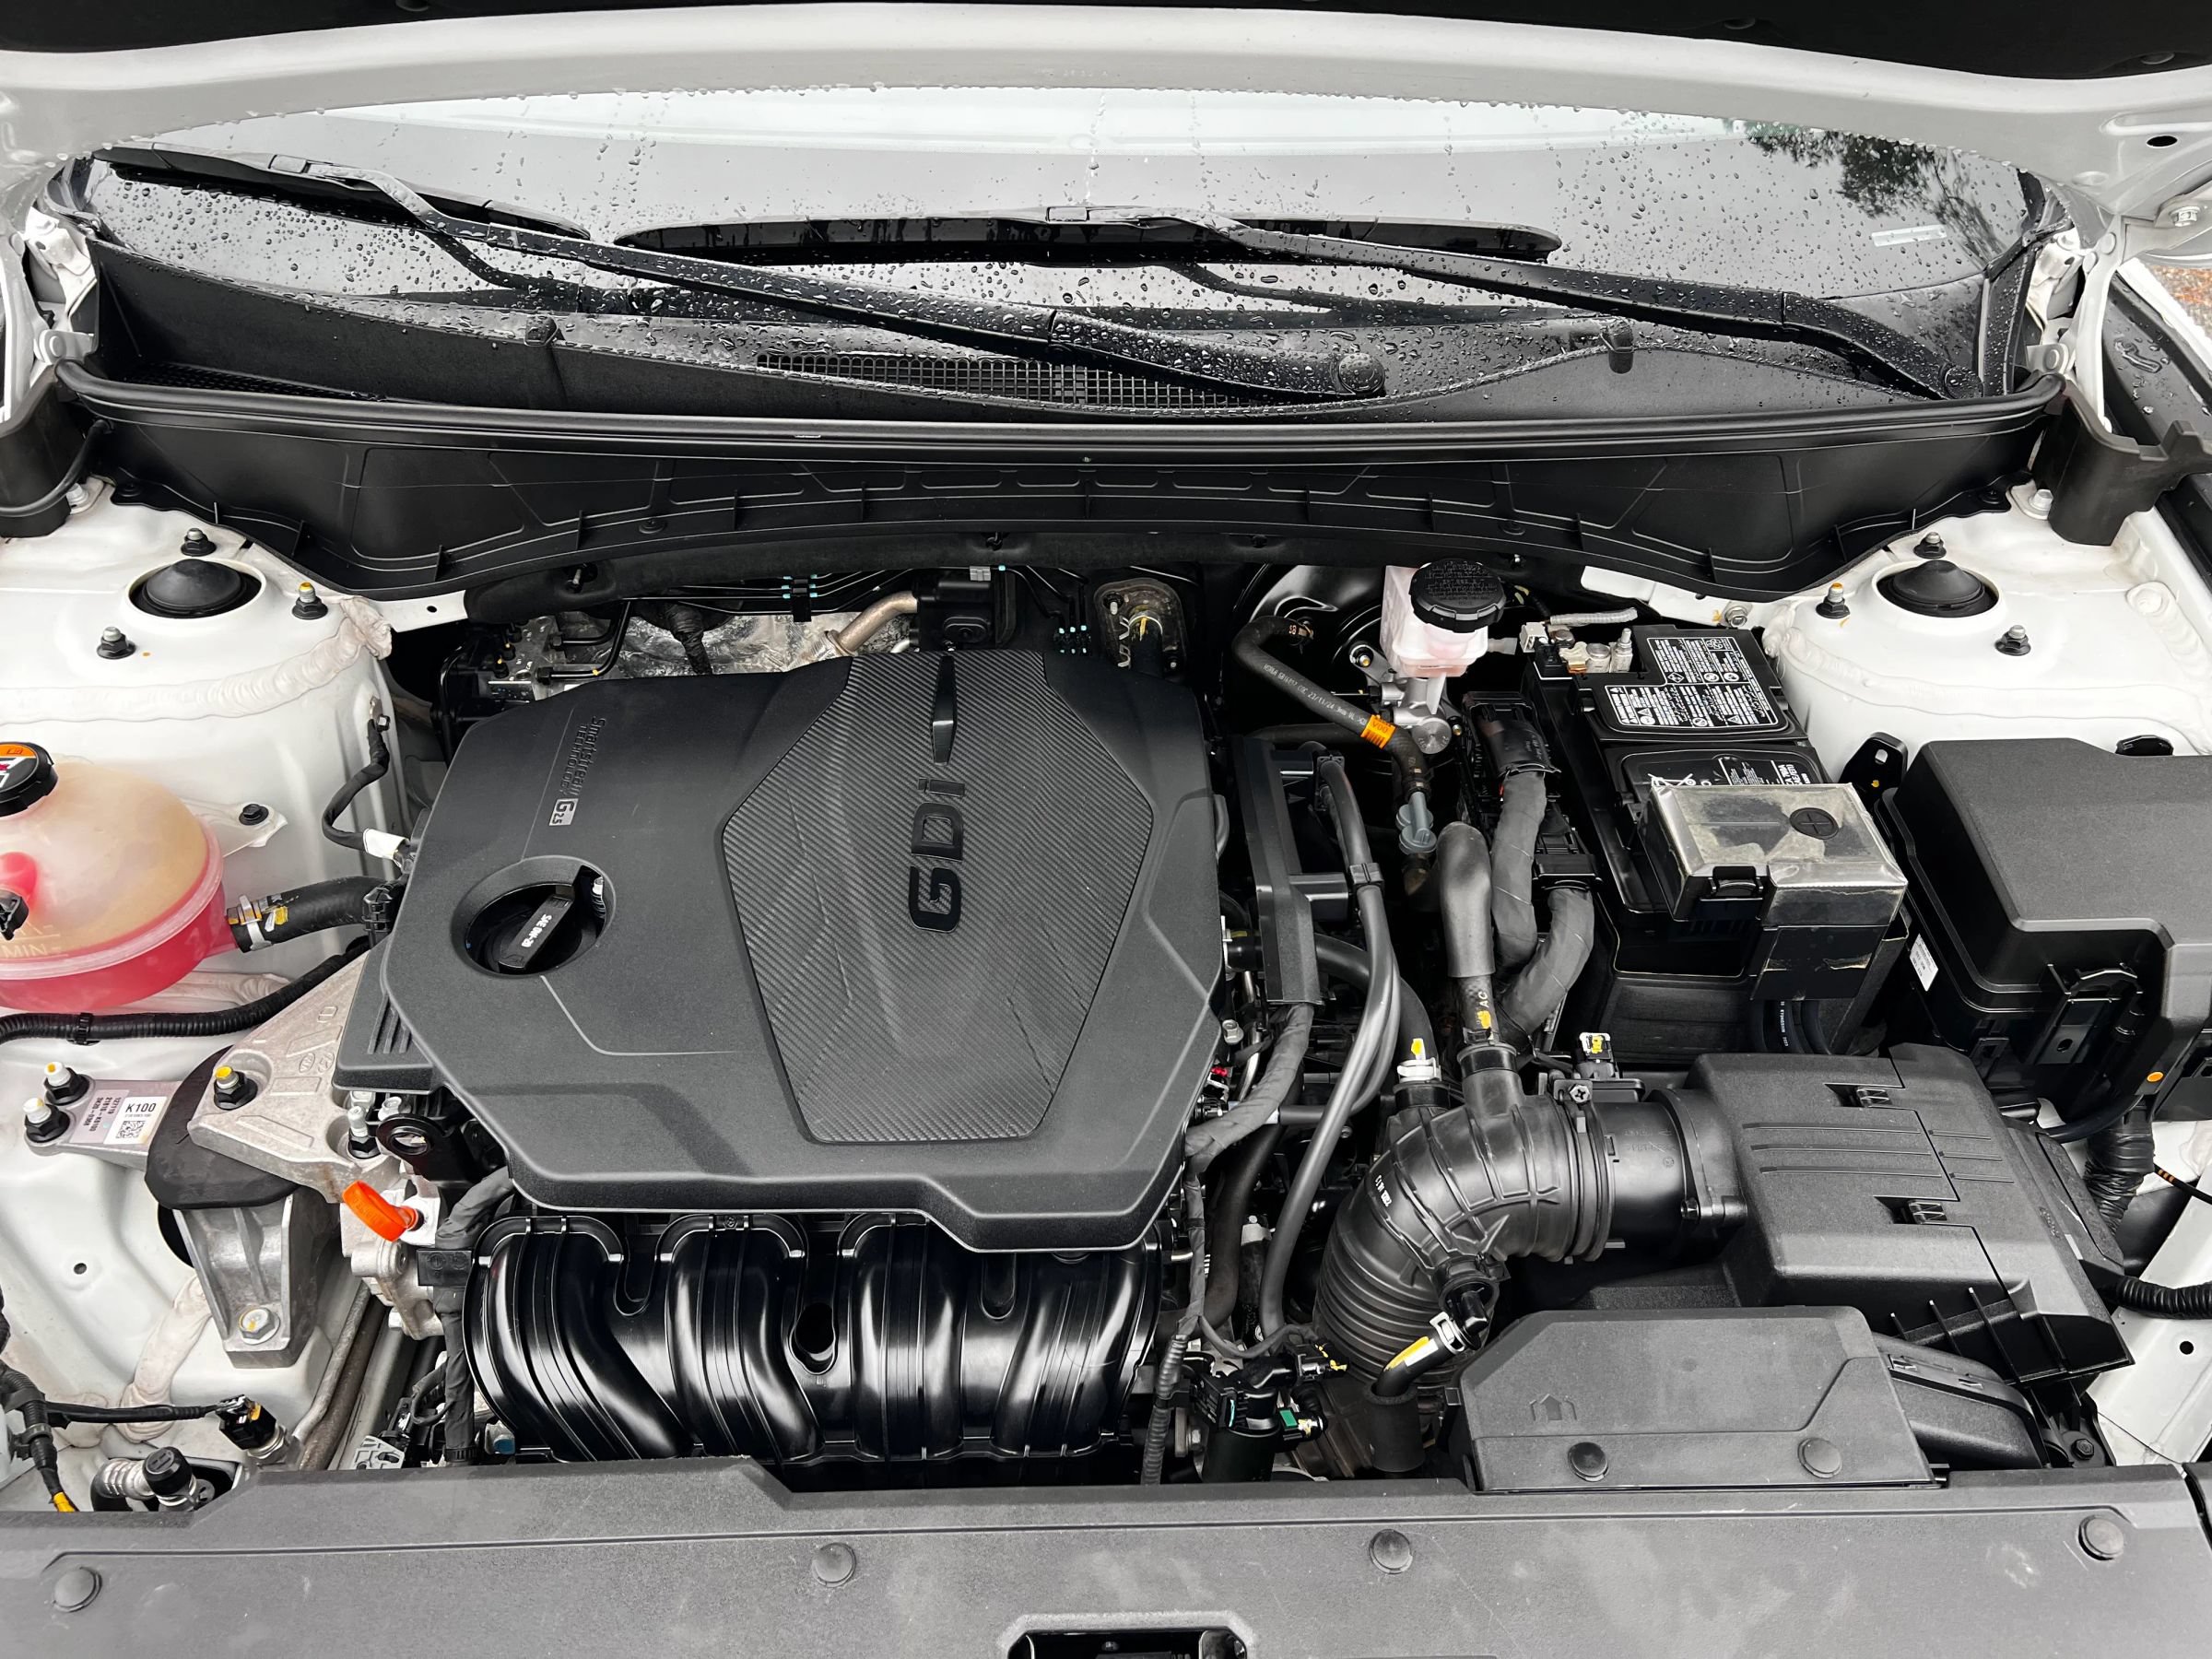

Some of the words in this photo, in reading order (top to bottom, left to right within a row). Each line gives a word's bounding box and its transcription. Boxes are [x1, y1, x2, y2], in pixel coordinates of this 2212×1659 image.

[559, 725, 587, 795] TECHNOLOGY
[571, 716, 606, 794] Smartstream
[535, 914, 552, 927] SAE
[4, 944, 47, 959] MIN
[1478, 991, 1489, 1007] AC
[125, 1102, 157, 1112] K100
